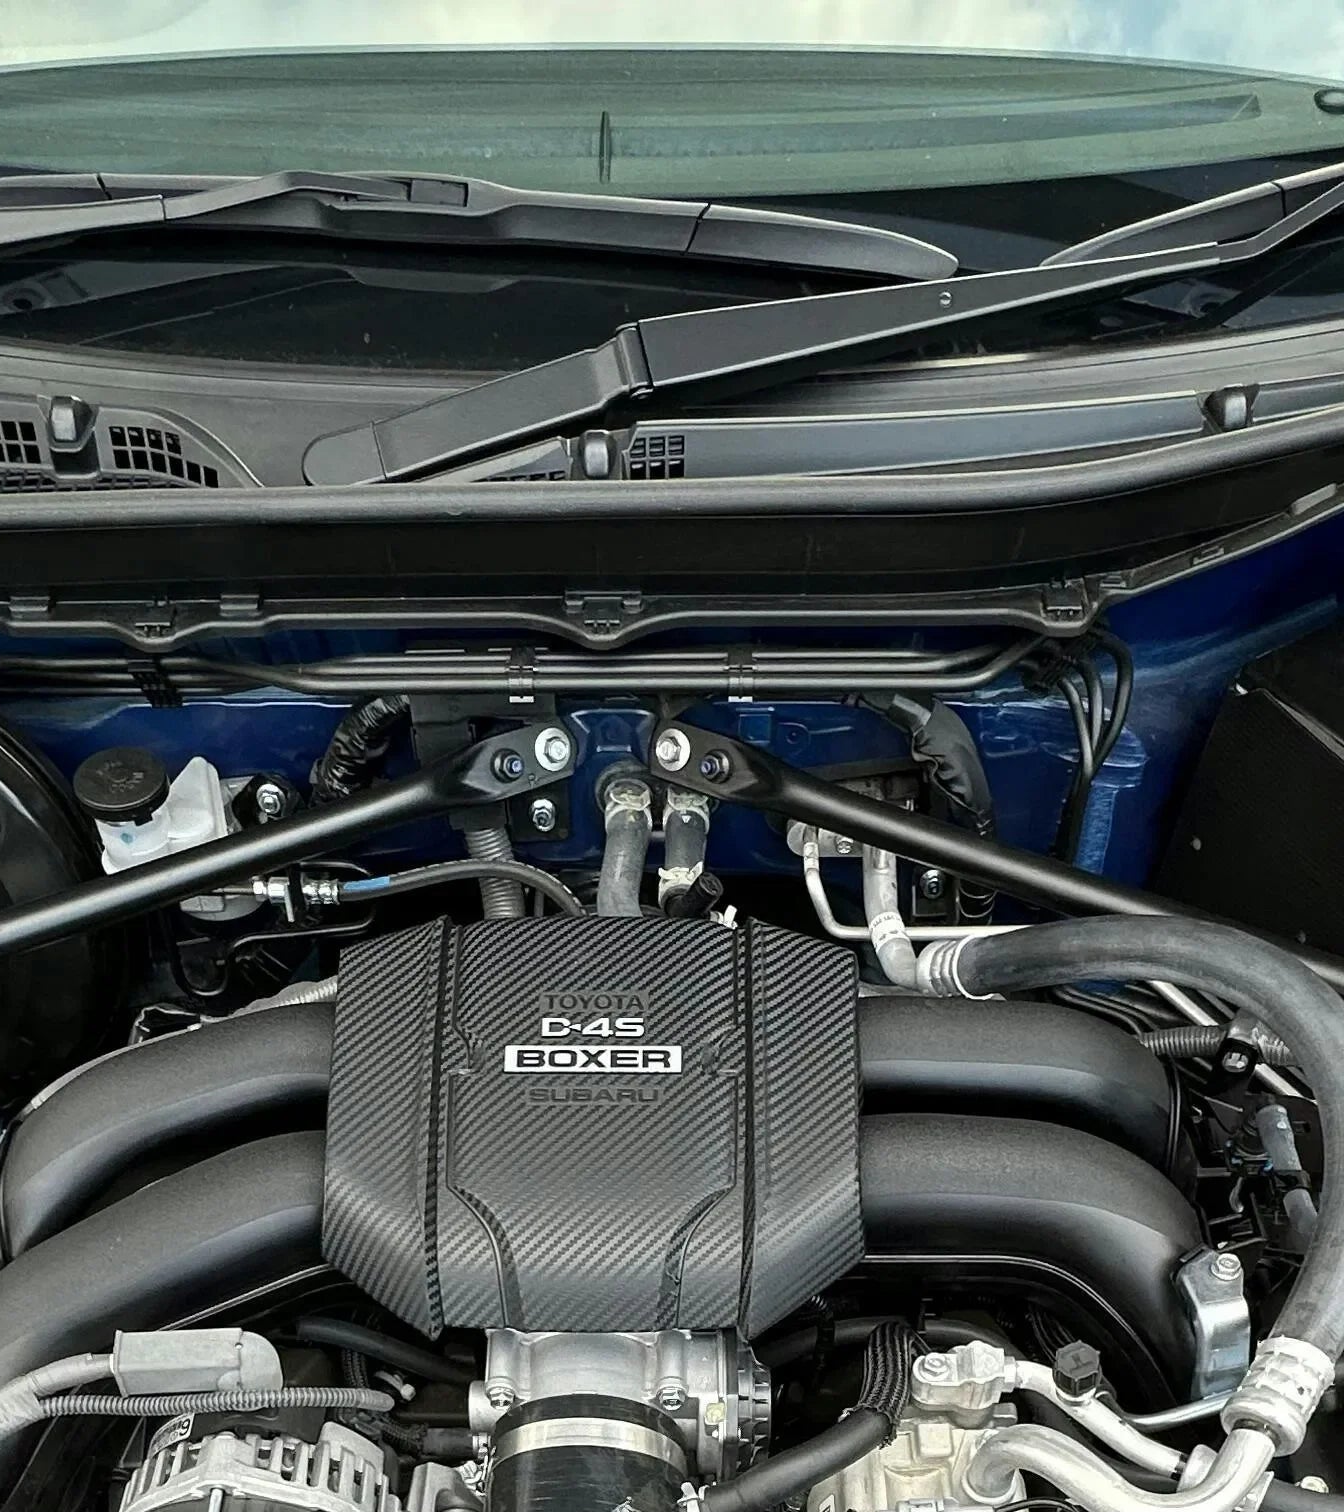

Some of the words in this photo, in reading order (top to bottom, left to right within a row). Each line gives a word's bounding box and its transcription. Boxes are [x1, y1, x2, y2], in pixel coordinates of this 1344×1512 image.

[545, 994, 644, 1011] TOYOTA
[541, 1017, 645, 1038] D-4S
[516, 1049, 672, 1069] BOXER
[528, 1087, 660, 1104] SUBARU
